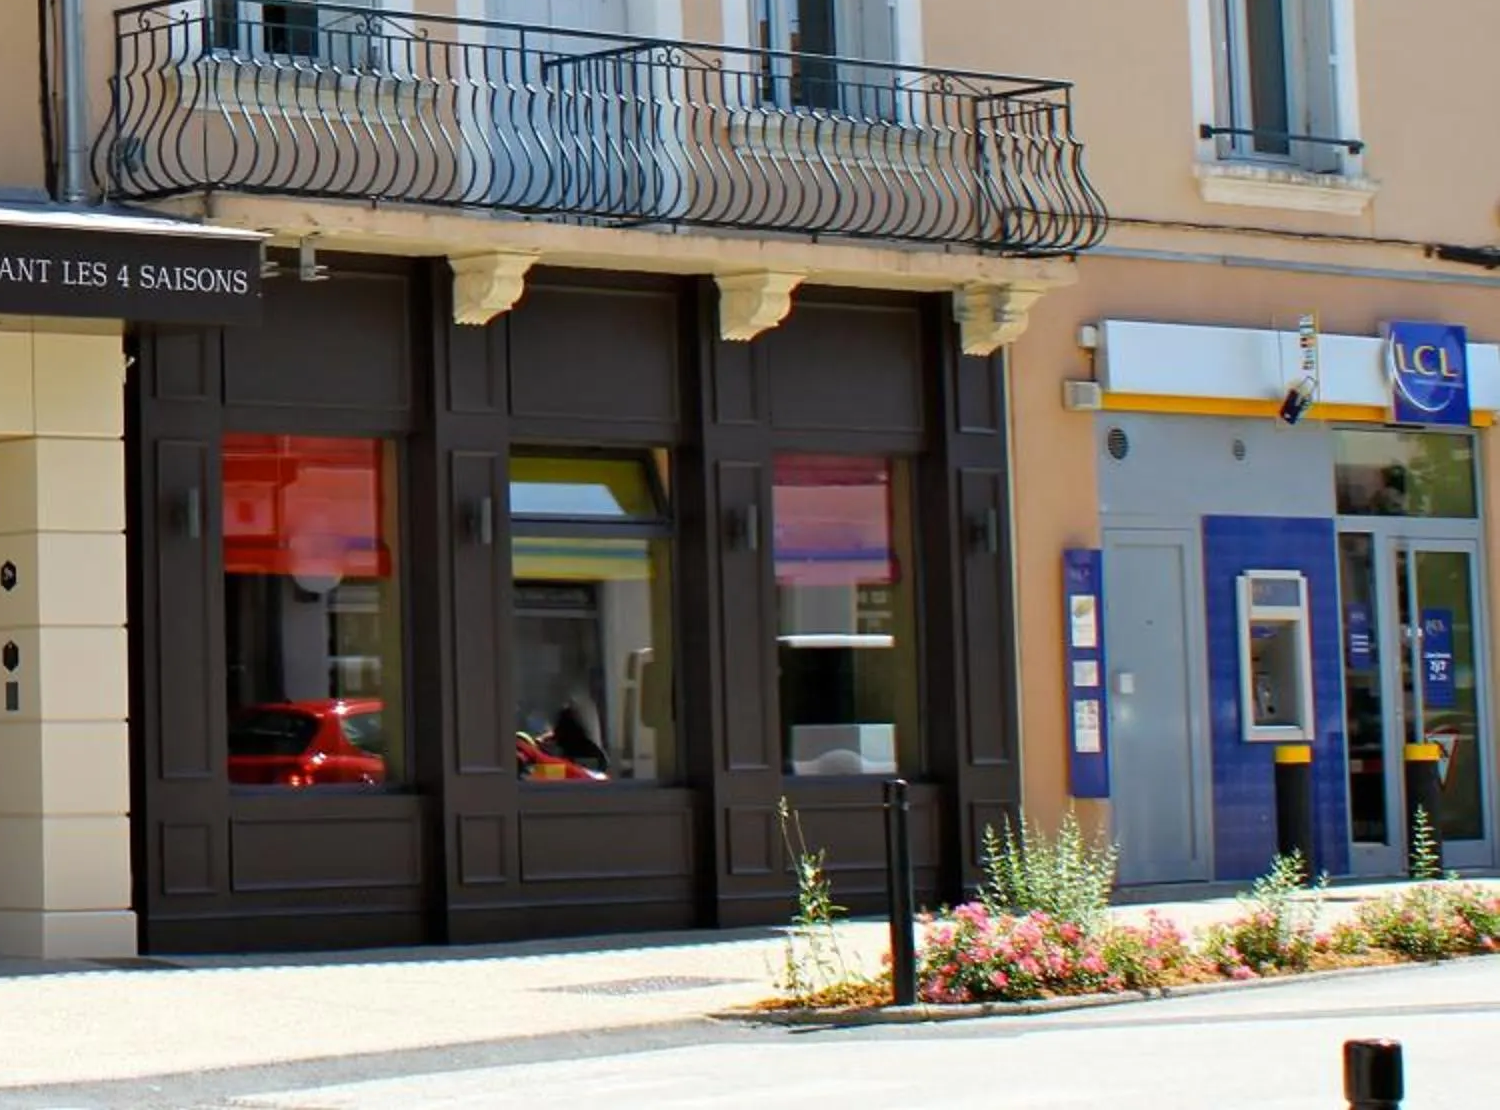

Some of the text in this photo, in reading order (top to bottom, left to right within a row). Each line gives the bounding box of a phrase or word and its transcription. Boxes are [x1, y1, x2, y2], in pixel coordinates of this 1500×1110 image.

[62, 260, 108, 288] LES
[116, 264, 129, 288] 4
[139, 265, 249, 294] SAISONS
[1395, 343, 1458, 378] LCL
